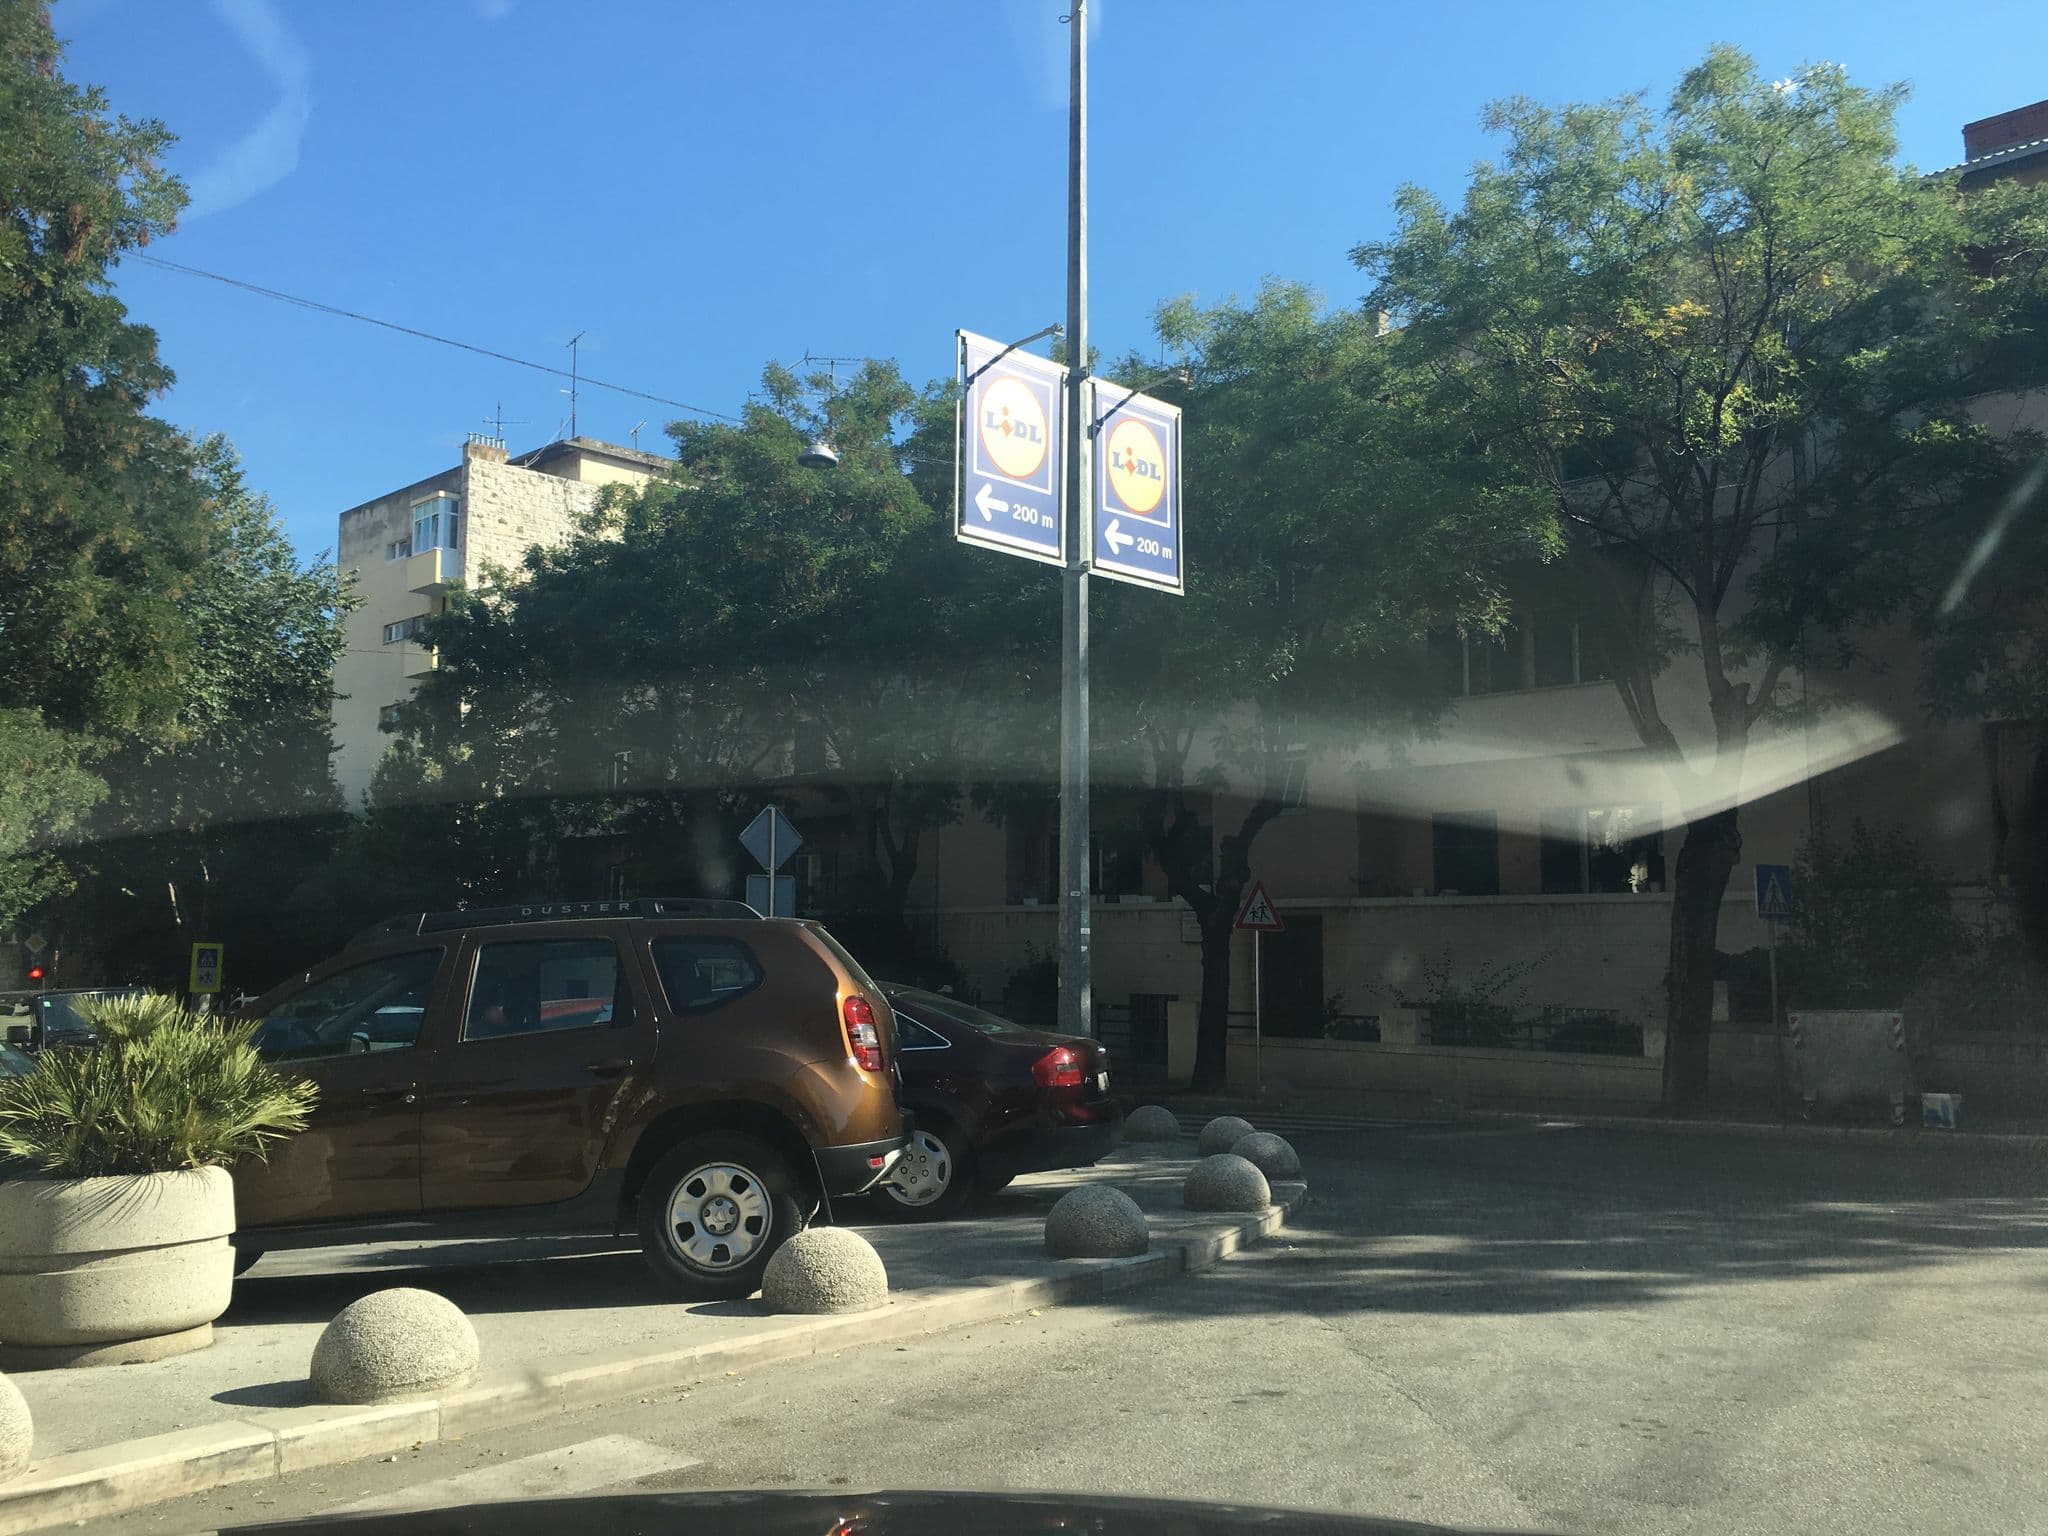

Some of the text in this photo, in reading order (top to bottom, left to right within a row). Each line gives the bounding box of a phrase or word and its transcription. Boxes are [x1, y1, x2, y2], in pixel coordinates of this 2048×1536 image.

[1012, 503, 1053, 529] 200 m
[1136, 537, 1173, 560] 200 m
[521, 902, 631, 916] DUSTER
